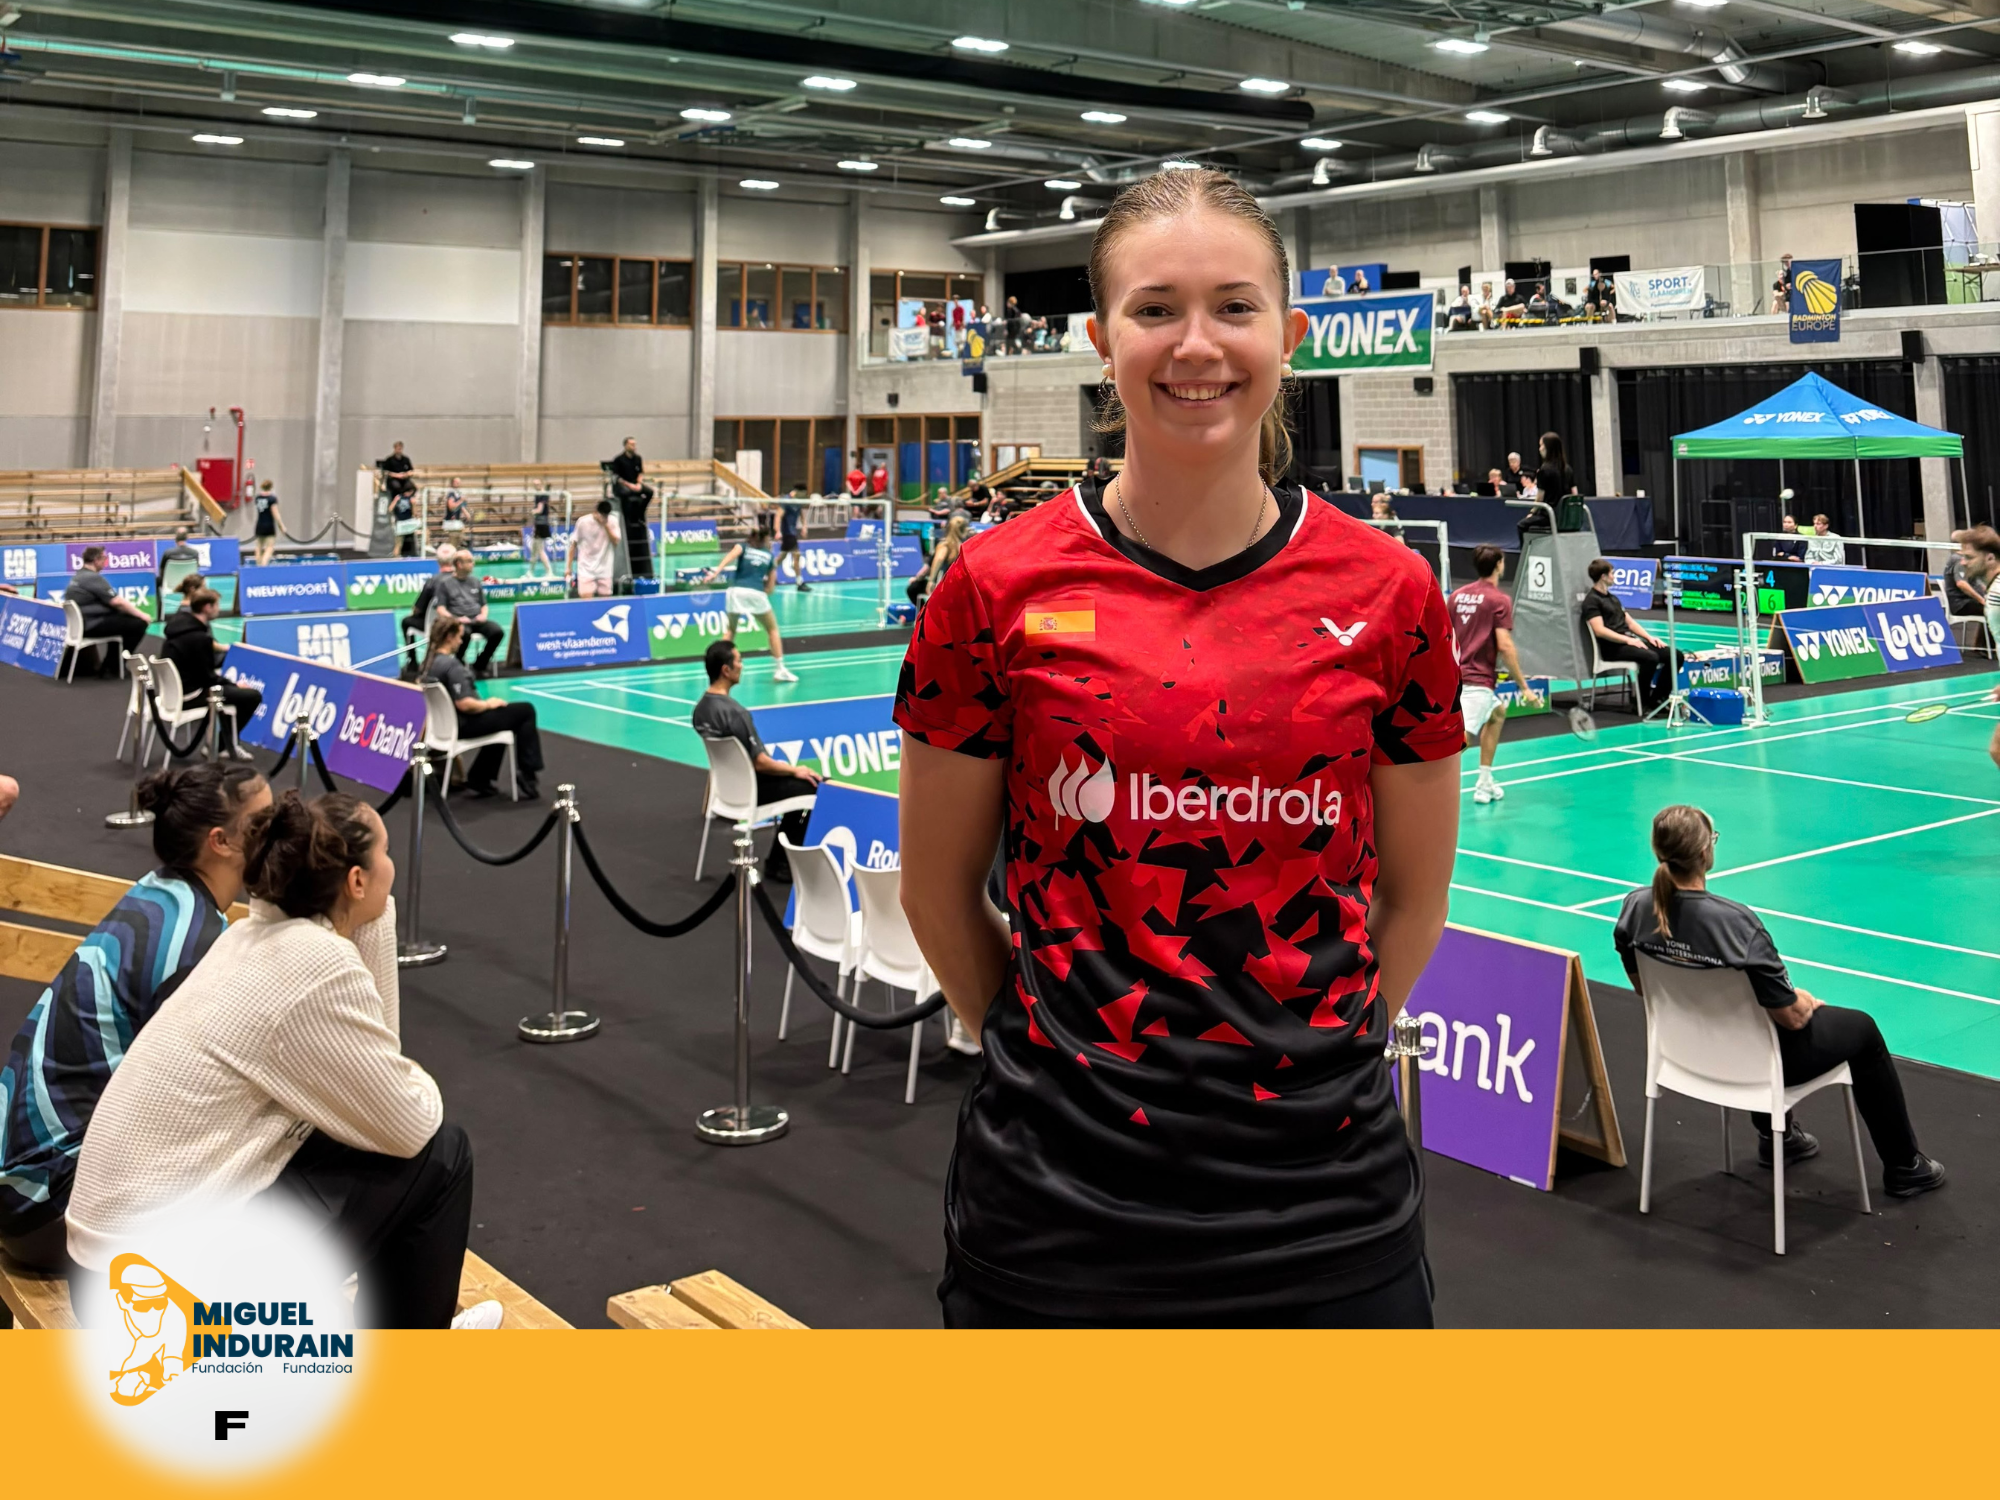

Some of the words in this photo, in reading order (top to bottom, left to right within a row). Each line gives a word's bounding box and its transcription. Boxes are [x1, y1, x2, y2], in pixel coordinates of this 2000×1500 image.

[1792, 313, 1836, 321] BADMINTON
[1792, 320, 1836, 331] EUROPE
[1309, 308, 1420, 358] YONEX
[1776, 411, 1826, 424] YONEX
[679, 529, 714, 543] YONEX
[71, 550, 151, 570] bbank
[384, 573, 433, 594] YONE
[1534, 561, 1546, 588] 3
[1612, 568, 1652, 587] ena
[1765, 570, 1775, 588] 4
[246, 582, 329, 598] NIEUWPOORT
[1768, 594, 1776, 611] 6
[1821, 626, 1876, 657] YONEX
[1701, 667, 1730, 684] YONEX
[1759, 660, 1781, 677] ONEX
[809, 730, 903, 778] YONE
[1129, 772, 1341, 826] Iberdrola
[1666, 940, 1691, 951] YONEX
[1398, 1007, 1536, 1103] ank
